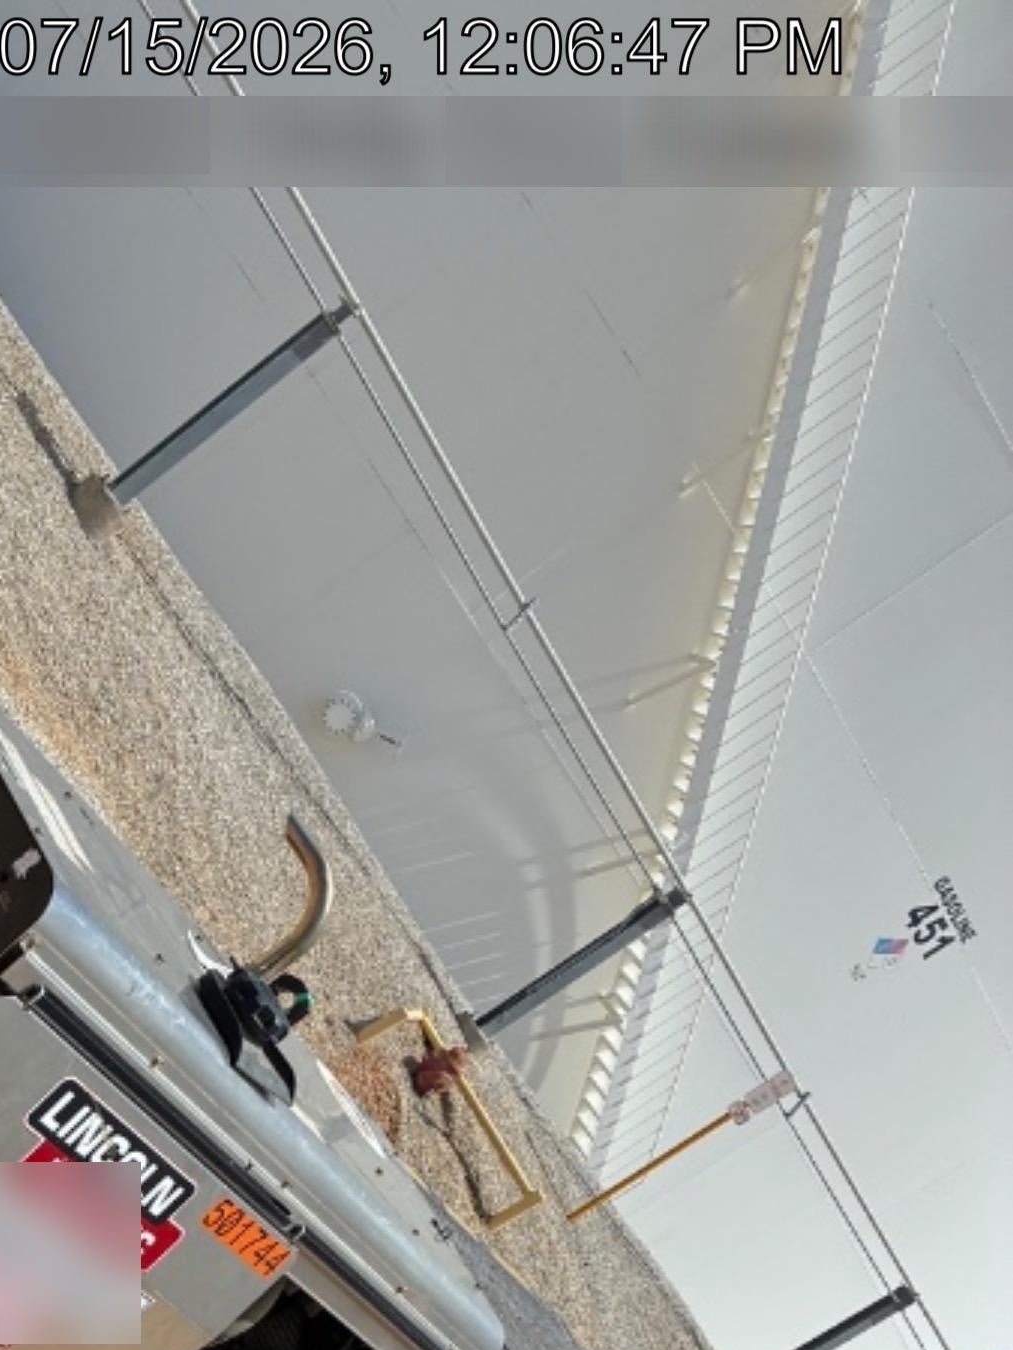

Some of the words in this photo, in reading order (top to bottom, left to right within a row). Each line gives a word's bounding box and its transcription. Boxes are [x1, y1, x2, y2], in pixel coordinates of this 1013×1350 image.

[907, 904, 956, 960] 451
[934, 875, 977, 944] GASOLINE
[203, 1198, 291, 1275] 501744
